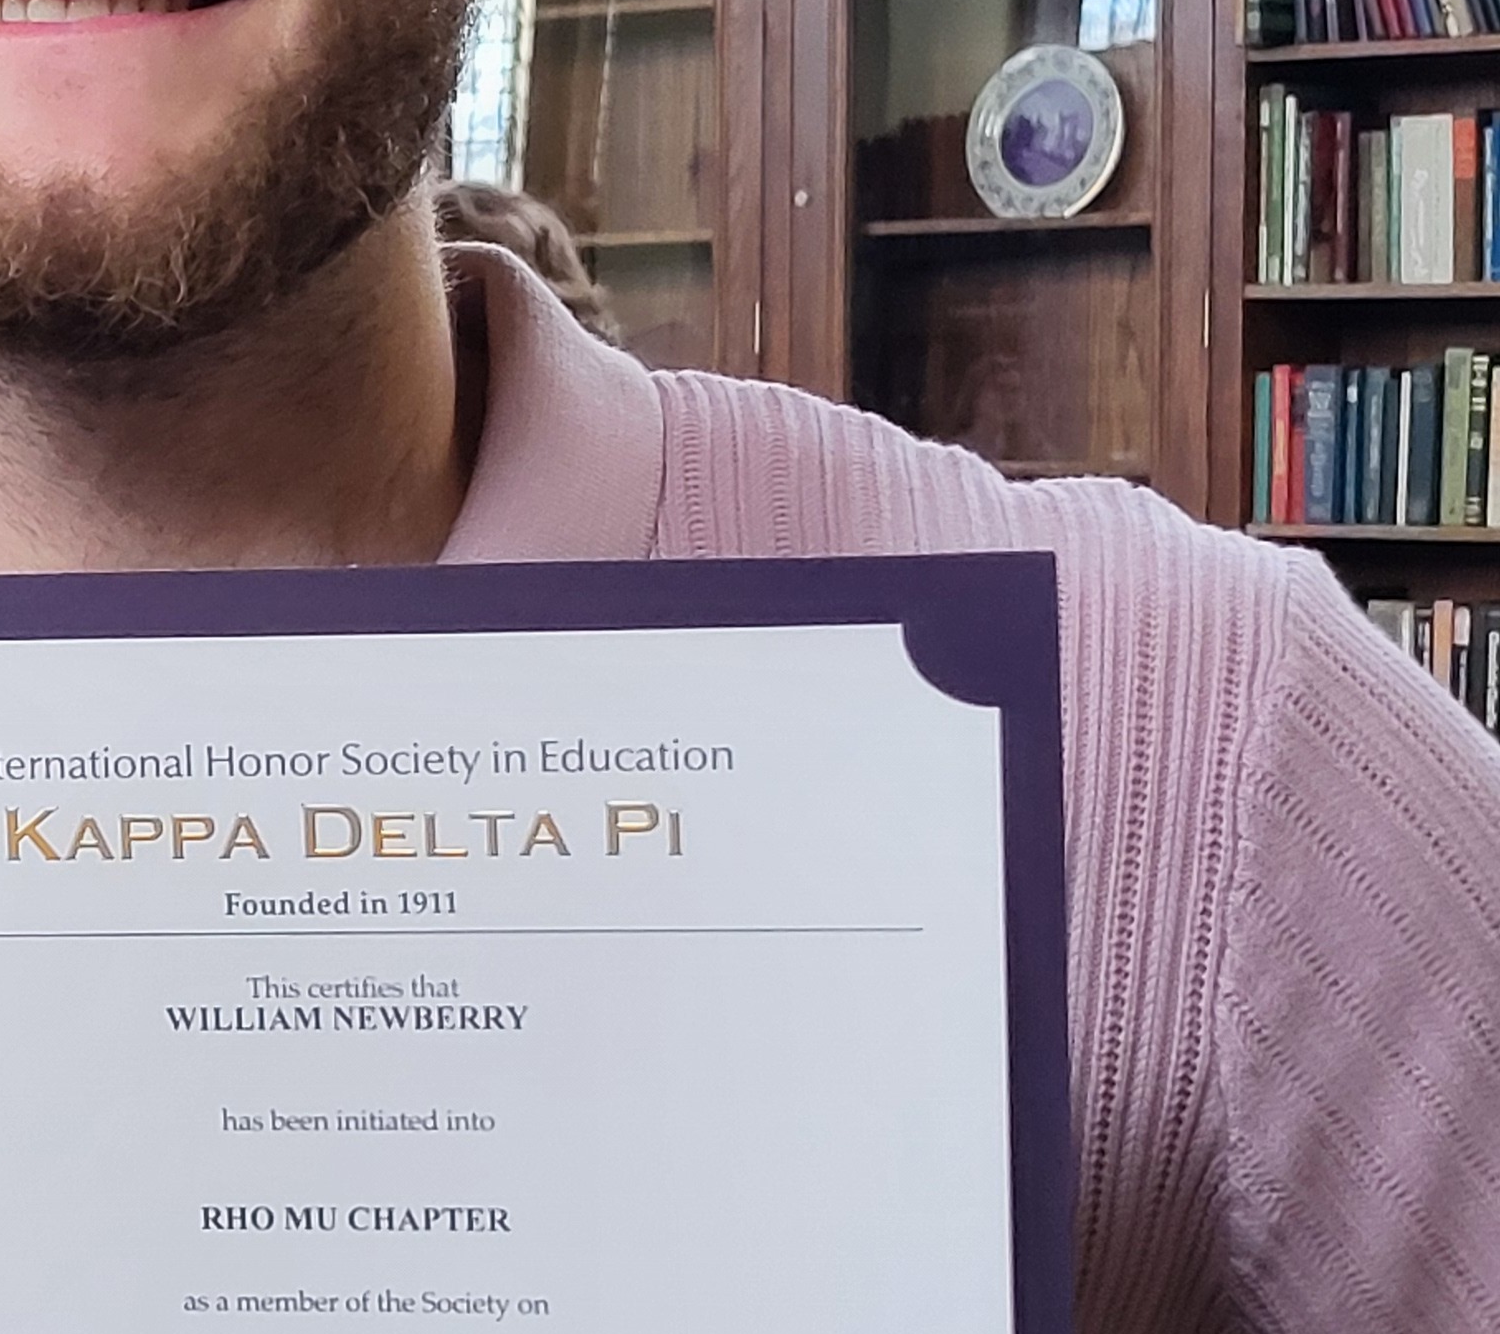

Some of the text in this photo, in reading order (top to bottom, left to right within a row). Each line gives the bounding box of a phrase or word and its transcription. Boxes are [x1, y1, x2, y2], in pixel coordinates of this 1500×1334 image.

[206, 745, 331, 777] Honor
[342, 742, 481, 785] Society
[492, 740, 527, 774] in
[540, 738, 734, 774] Education
[4, 802, 684, 862] KAPPA DELTA PI
[224, 890, 456, 916] Founded in 1911
[245, 973, 460, 999] This certifies that
[165, 1005, 528, 1032] WILLIAM NEWBERRY
[221, 1107, 496, 1132] has been initiated into
[201, 1206, 511, 1233] RHO MU CHAPTER
[183, 1288, 550, 1323] as a member of the Society on
